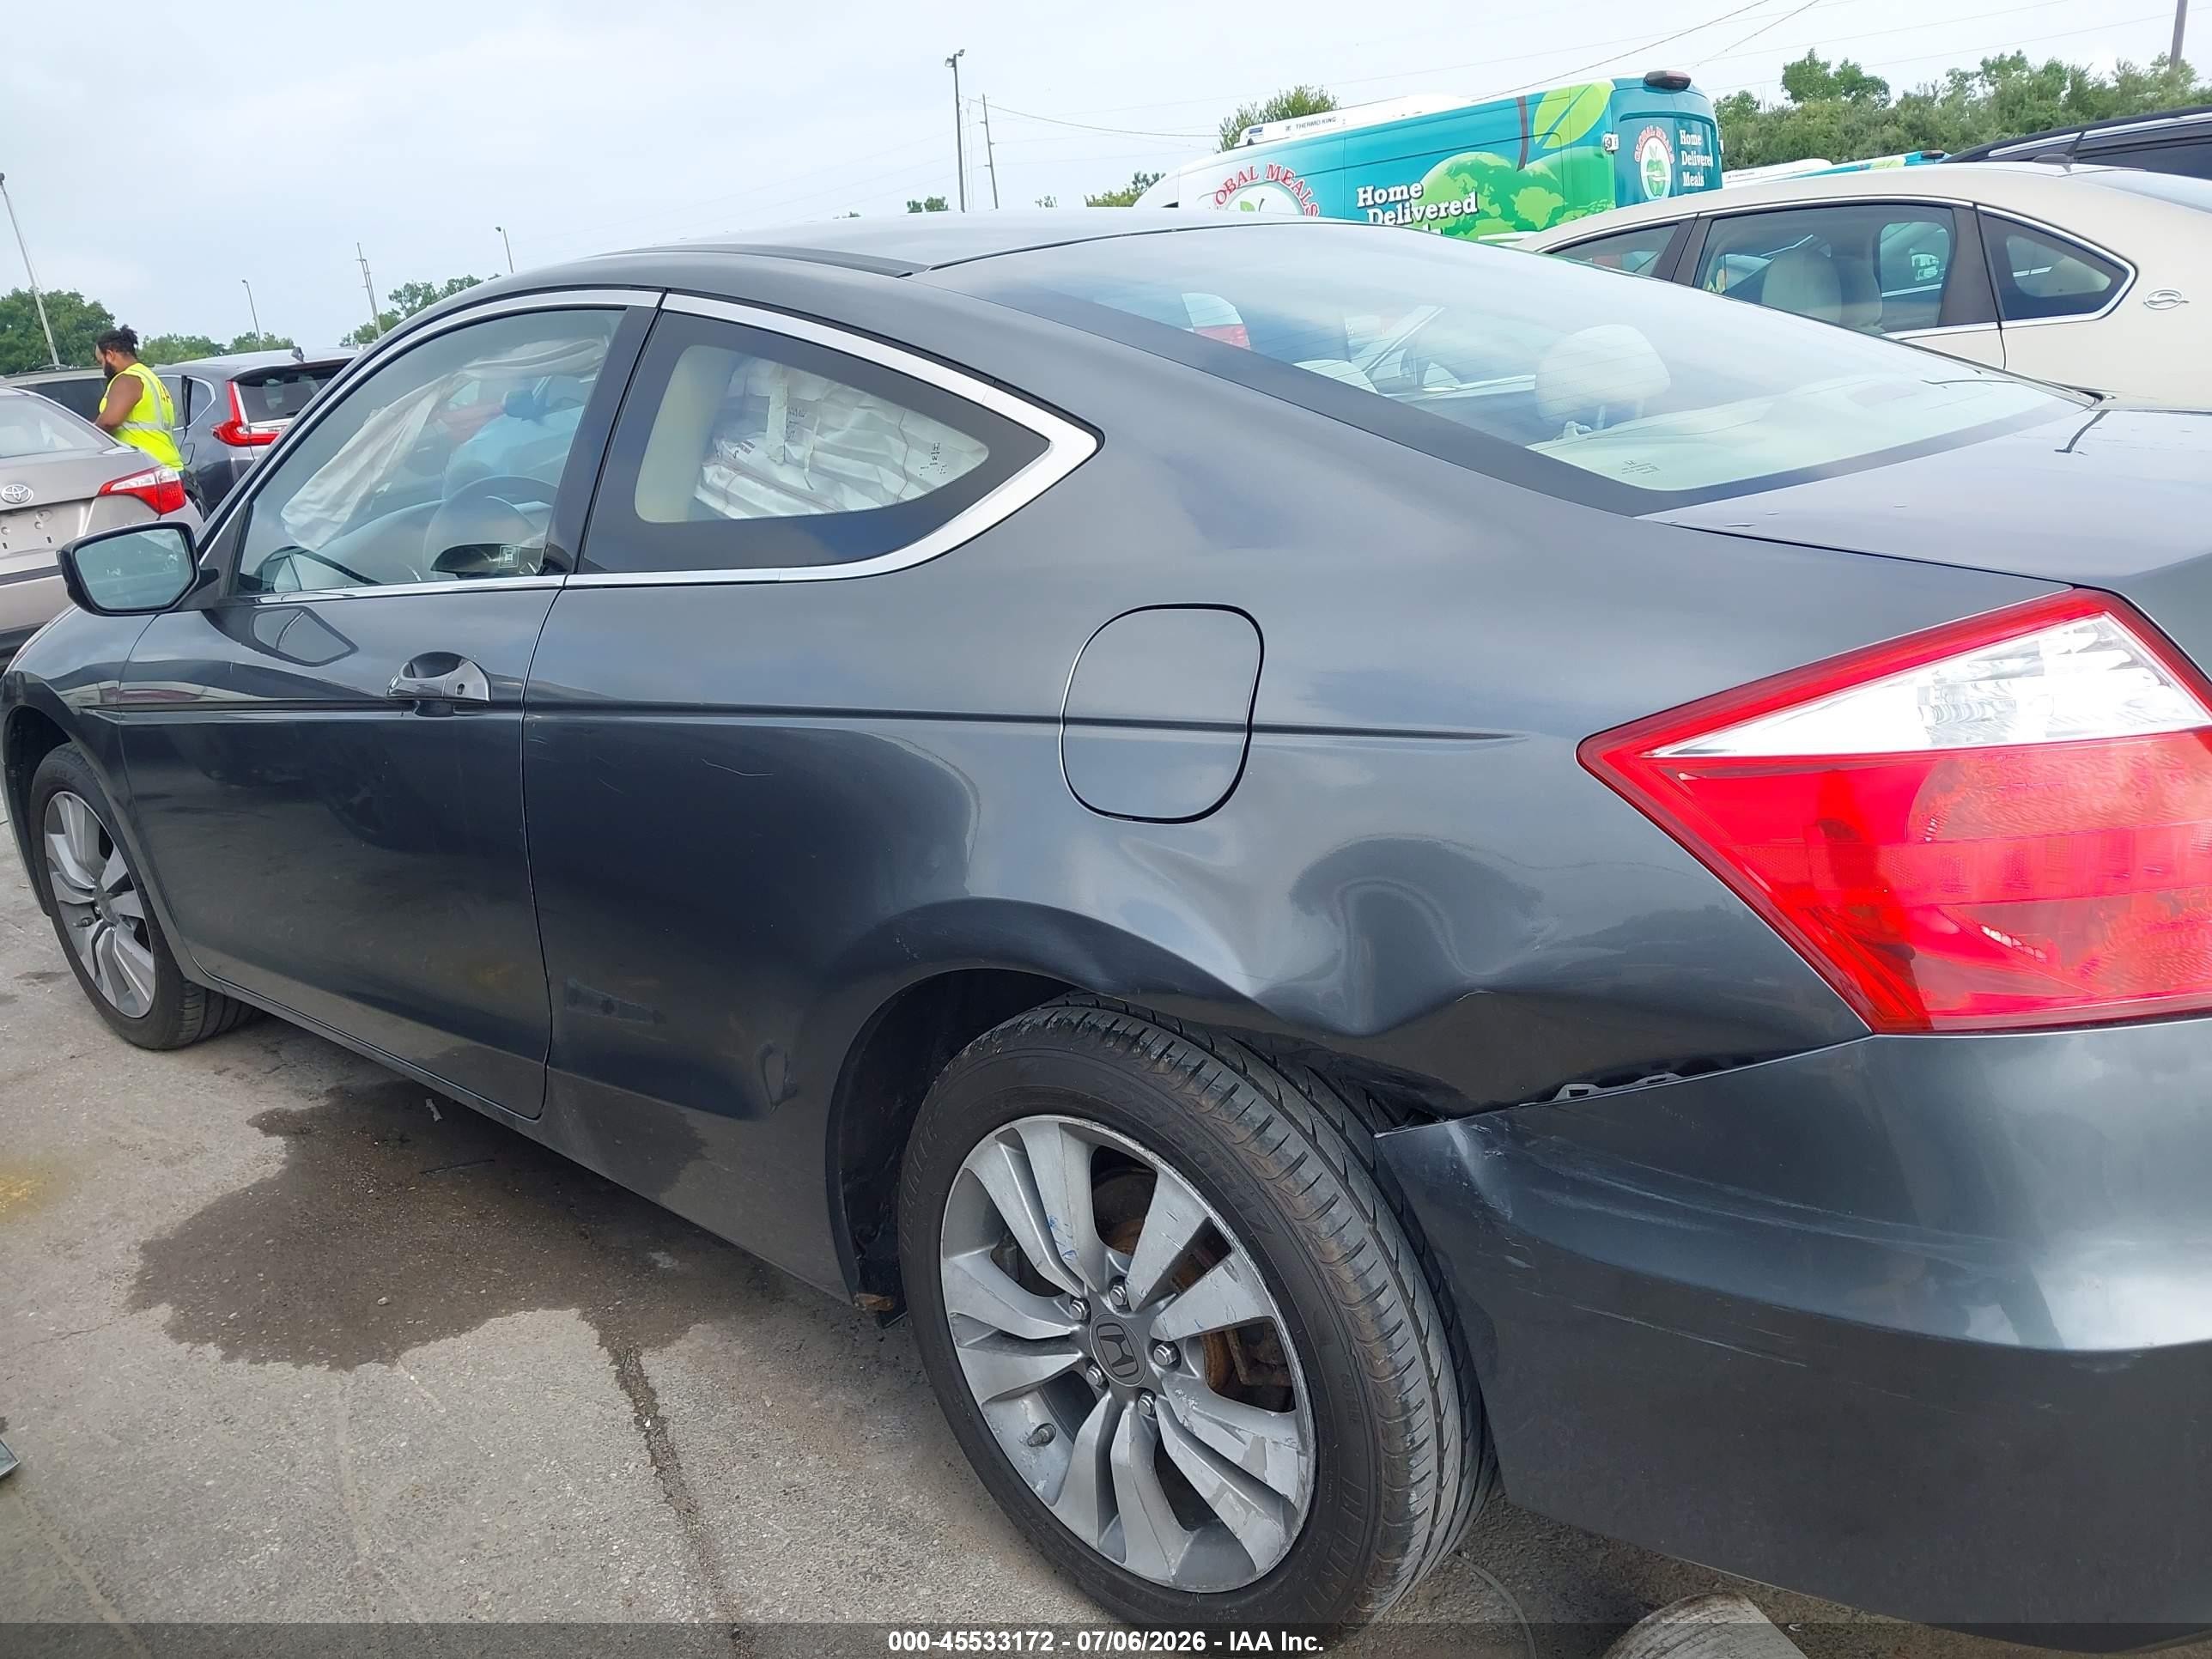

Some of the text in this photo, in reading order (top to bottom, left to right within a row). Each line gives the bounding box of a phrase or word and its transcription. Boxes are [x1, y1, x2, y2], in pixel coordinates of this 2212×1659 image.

[1680, 130, 1702, 146] Home
[1681, 150, 1714, 167] Delivered
[1214, 163, 1319, 216] OBAL MEALS
[1683, 171, 1705, 187] Meals
[1357, 182, 1424, 208] Home
[1367, 190, 1478, 225] Delivered
